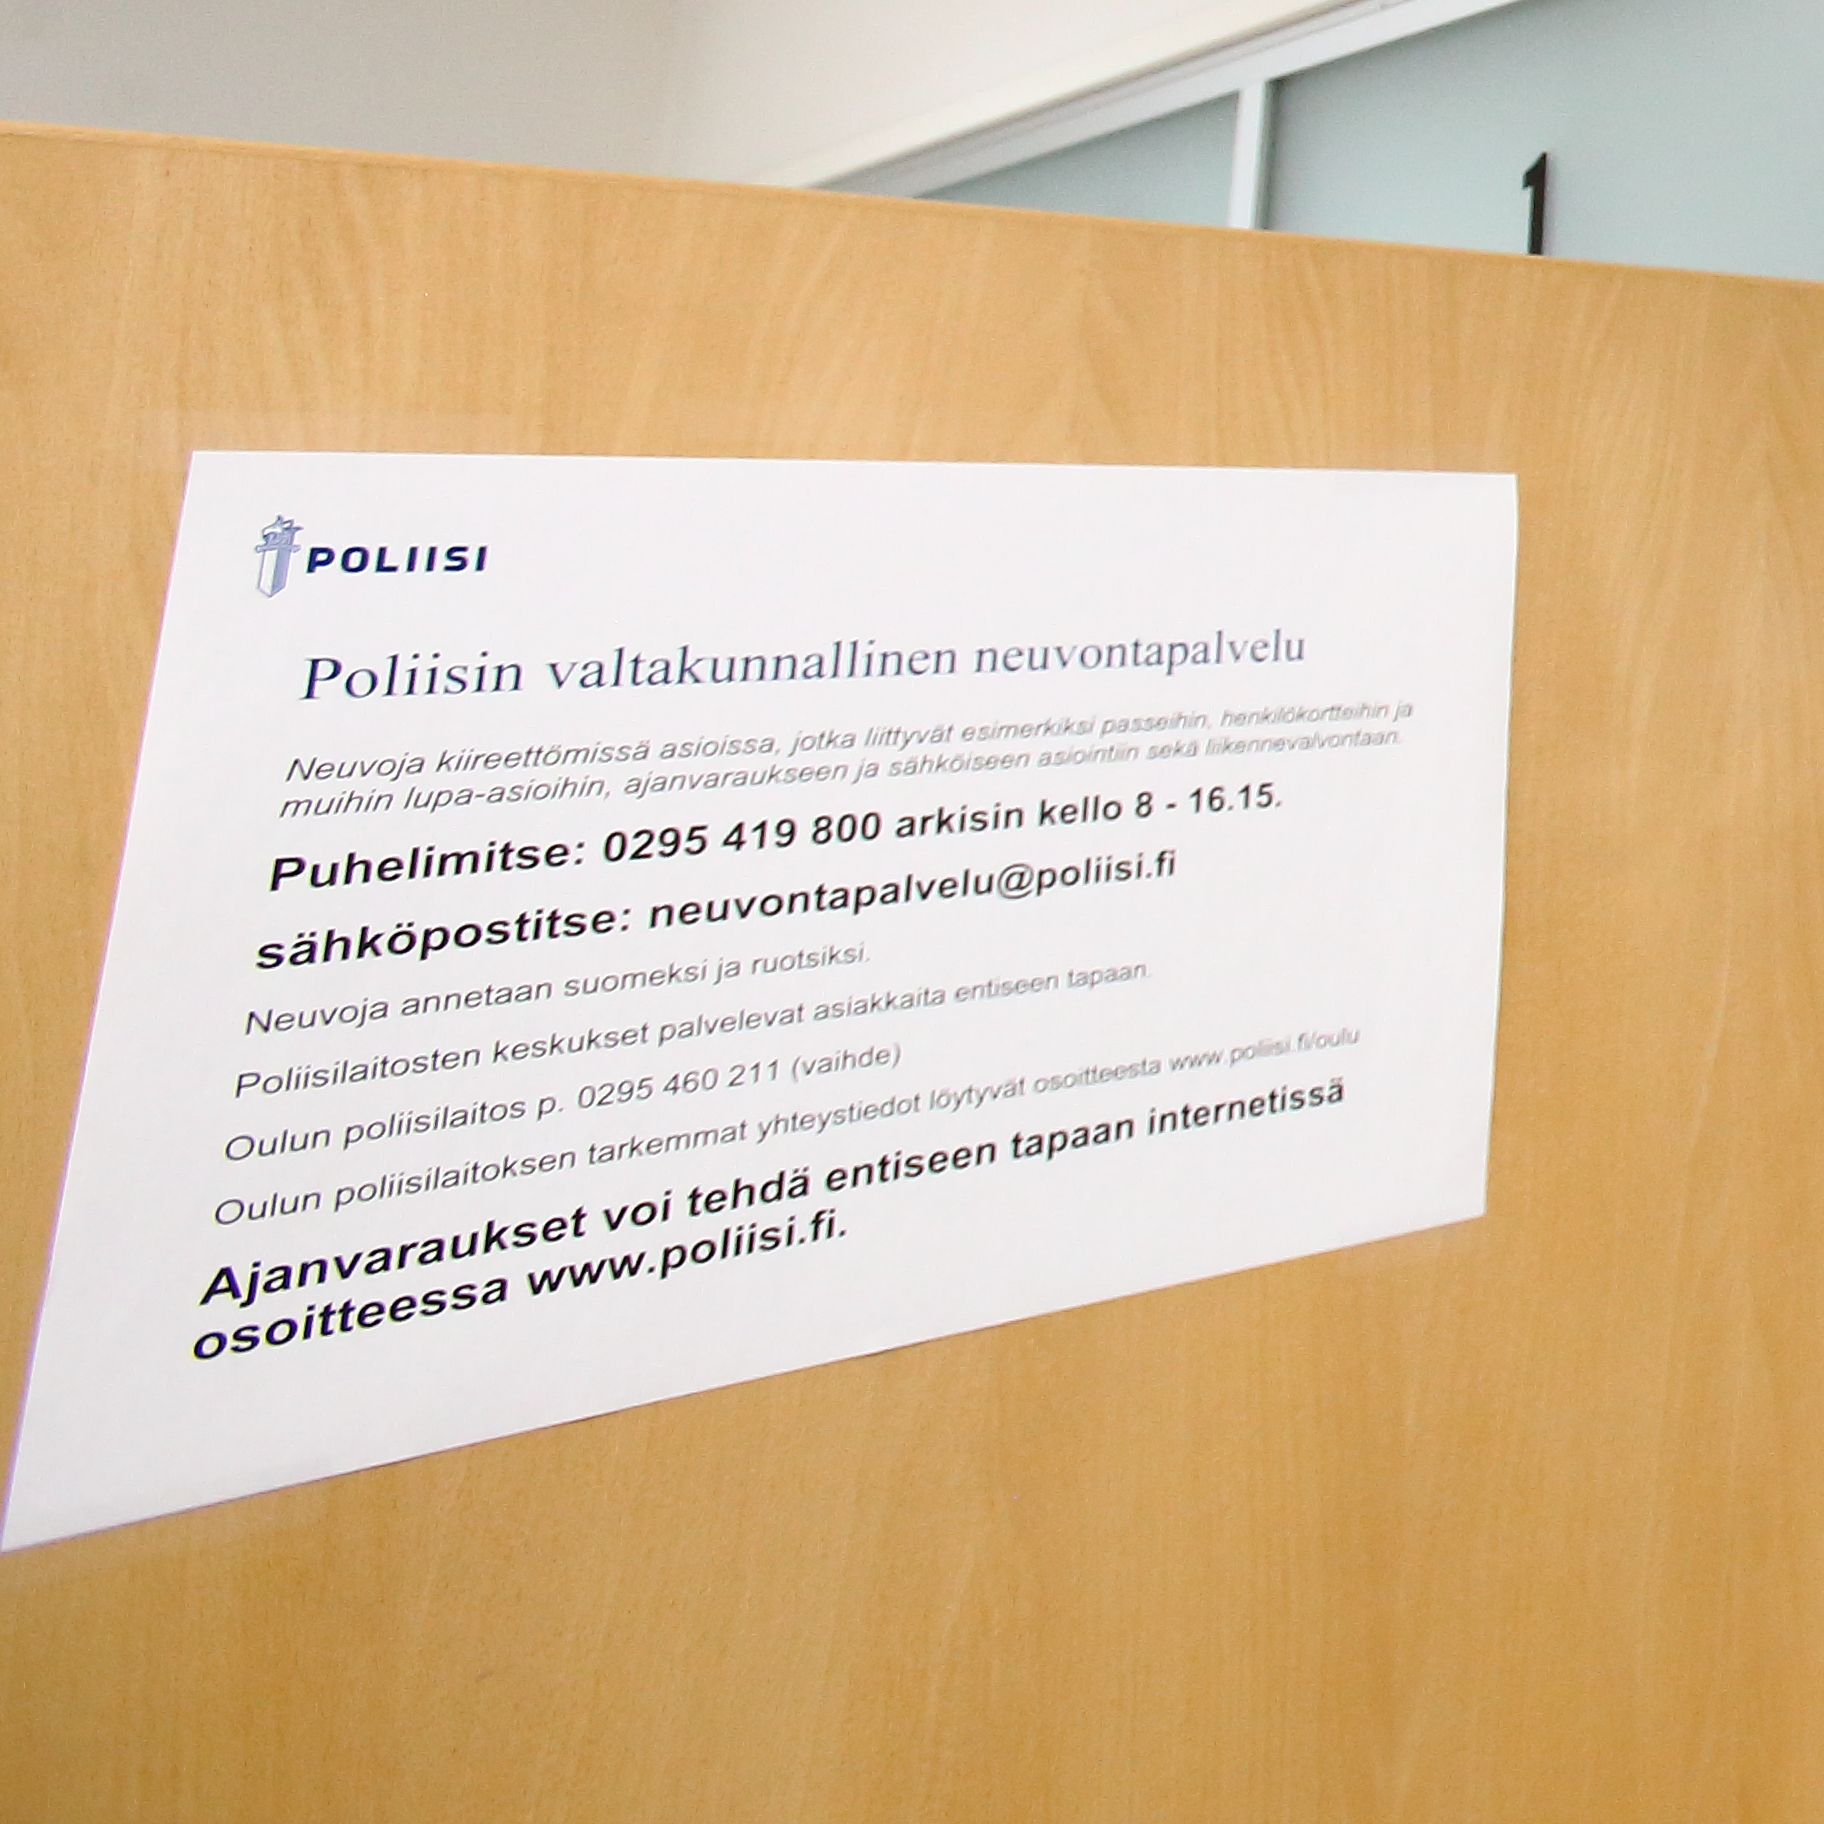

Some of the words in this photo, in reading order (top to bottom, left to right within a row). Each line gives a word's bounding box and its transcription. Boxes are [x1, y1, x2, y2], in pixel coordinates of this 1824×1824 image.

[1522, 151, 1549, 256] 1
[305, 545, 488, 575] POLIISI
[298, 650, 523, 701] Poliisin
[545, 639, 957, 690] valtakunnallinen
[973, 627, 1305, 677] neuvontapalvelu
[278, 787, 395, 820] muihin
[402, 774, 611, 815] lupa-asioihin,
[622, 763, 850, 801] ajanvaraukseen
[850, 756, 880, 786] ja
[886, 750, 1032, 778] sähköiseen
[1145, 738, 1200, 761] sekä
[284, 751, 427, 783] Neuvoja
[433, 738, 652, 774] kiireettömissä
[656, 733, 782, 761] asioissa,
[785, 728, 858, 759] jotka
[863, 723, 956, 752] liittyvät
[960, 714, 1097, 743] esimerkiksi
[1391, 699, 1415, 724] ja
[269, 840, 585, 892] Puhelimitse:
[602, 824, 709, 863] 0295
[721, 817, 798, 852] 419
[811, 811, 883, 846] 800
[894, 801, 1025, 839] arkisin
[1038, 794, 1123, 827] kello
[1134, 790, 1154, 820] 8
[1189, 781, 1282, 814] 16.15.
[255, 907, 632, 970] sähköpostitse:
[648, 849, 1176, 930] neuvontapalvelu@poliisi.fi
[234, 1047, 482, 1100] Poliisilaitosten
[491, 1020, 651, 1065] keskukset
[657, 1002, 806, 1049] palvelevat
[812, 986, 947, 1022] asiakkaita
[953, 974, 1060, 1004] entiseen
[243, 996, 390, 1037] Neuvoja
[399, 981, 553, 1017] annetaan
[563, 957, 709, 998] suomeksi
[712, 956, 742, 987] ja
[750, 940, 871, 976] ruotsiksi.
[214, 1191, 323, 1226] Oulun
[332, 1150, 577, 1214] poliisilaitoksen
[587, 1118, 749, 1166] tarkemmat
[755, 1091, 922, 1146] yhteystiedot
[928, 1075, 1026, 1114] löytyvät
[1032, 1056, 1163, 1095] osoitteesta
[224, 1128, 332, 1162] Oulun
[342, 1100, 527, 1152] poliisilaitos
[535, 1095, 565, 1123] p.
[577, 1075, 655, 1110] 0295
[661, 1067, 720, 1097] 460
[725, 1058, 779, 1088] 211
[790, 1042, 902, 1085] (vaihde)
[198, 1205, 589, 1310] Ajanvaraukset
[601, 1189, 673, 1233] voi
[686, 1166, 811, 1218] tehdä
[824, 1142, 998, 1193] entiseen
[1010, 1118, 1135, 1162] tapaan
[1147, 1076, 1345, 1136] internetissä
[193, 1277, 509, 1361] osoitteessa
[526, 1207, 847, 1297] www.poliisi.fi.
